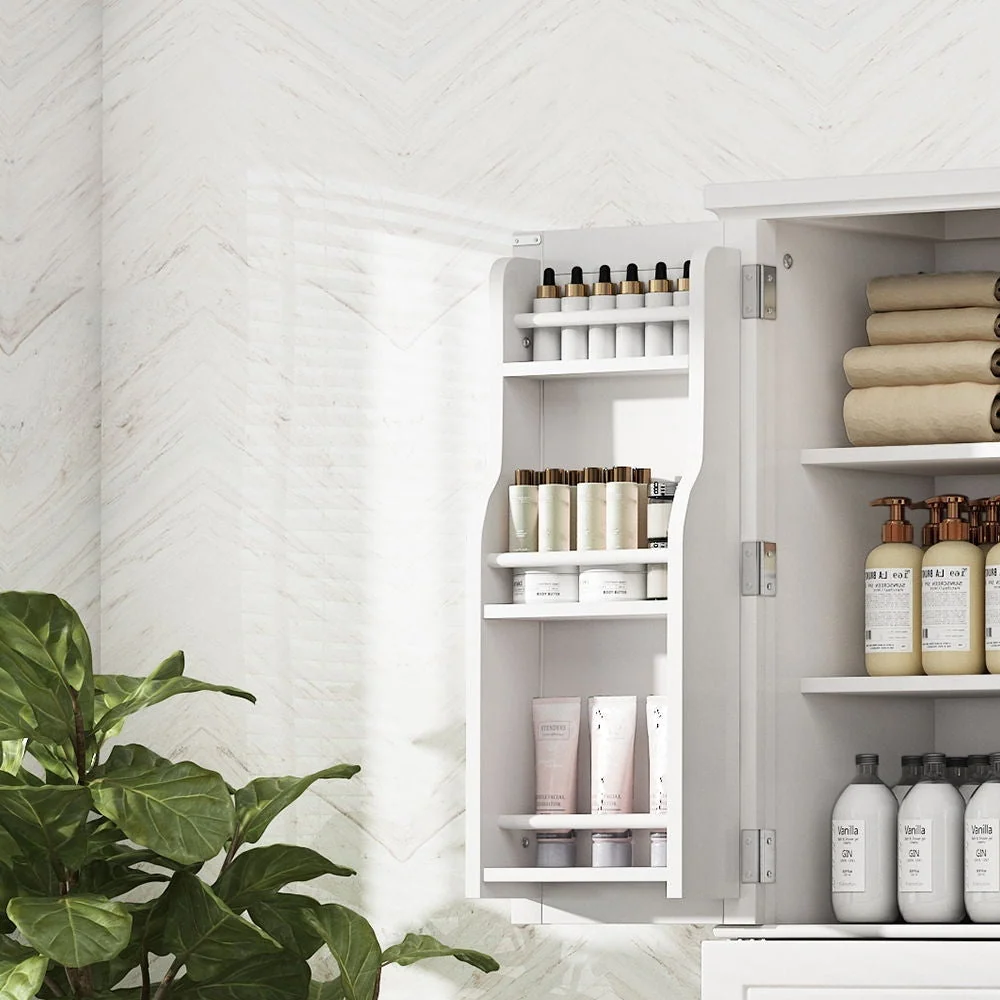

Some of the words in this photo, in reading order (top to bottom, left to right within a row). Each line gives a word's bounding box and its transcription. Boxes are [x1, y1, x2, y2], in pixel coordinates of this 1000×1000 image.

[838, 826, 858, 835] Vanilla
[904, 825, 925, 835] Vanilla
[972, 824, 992, 834] Vanilla
[842, 850, 852, 858] GIN
[909, 849, 920, 857] GIN
[976, 849, 986, 857] GIN
